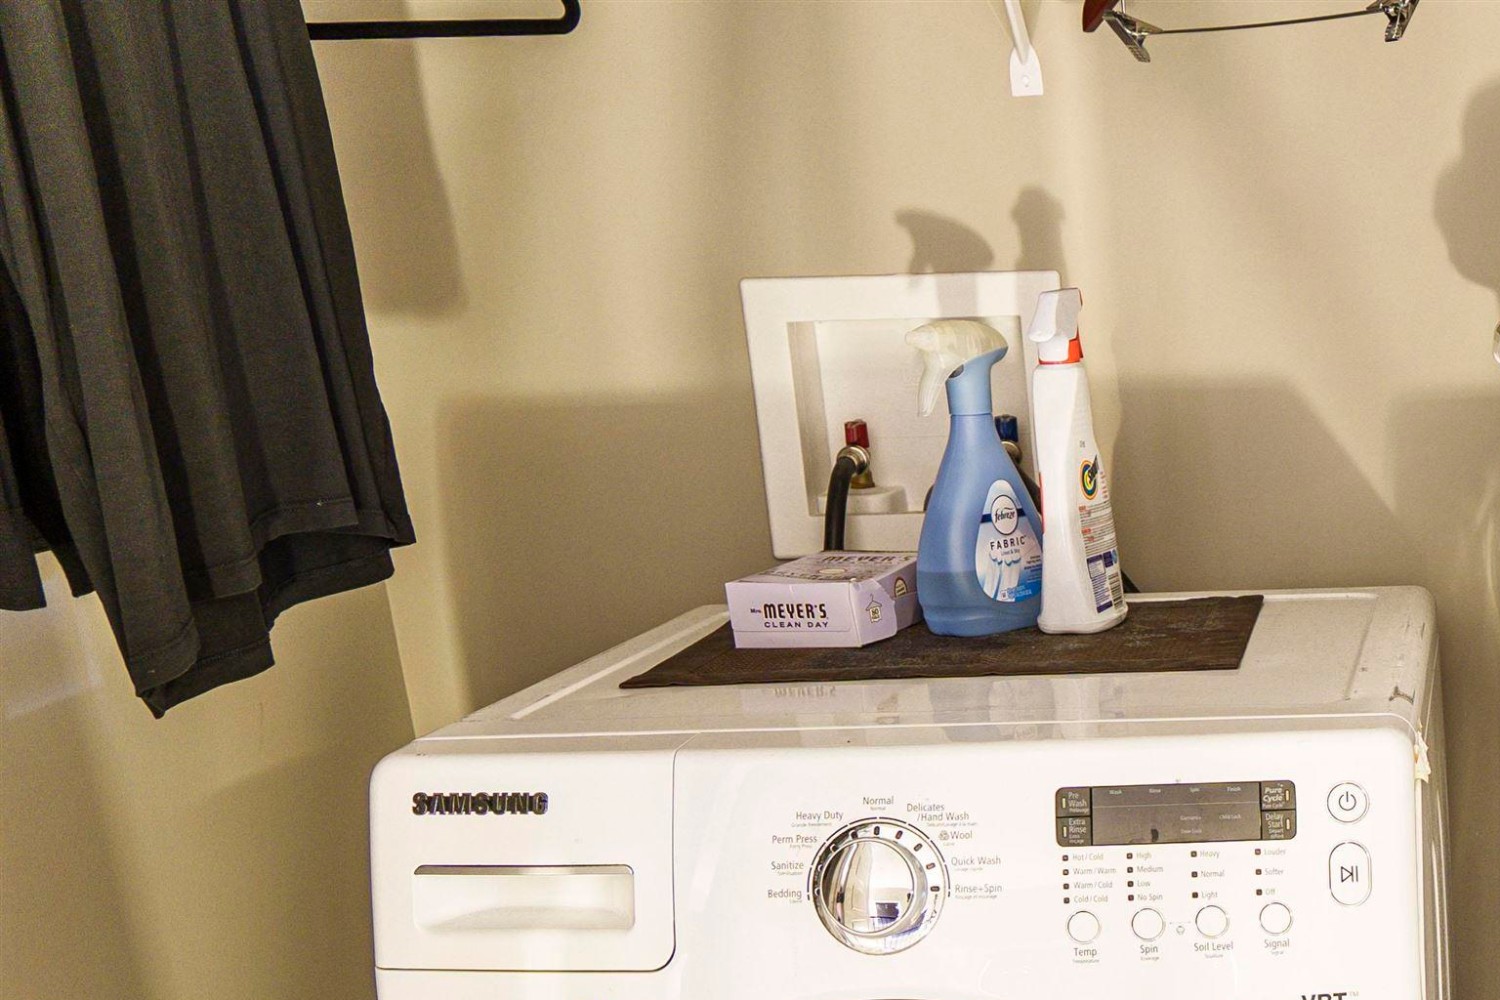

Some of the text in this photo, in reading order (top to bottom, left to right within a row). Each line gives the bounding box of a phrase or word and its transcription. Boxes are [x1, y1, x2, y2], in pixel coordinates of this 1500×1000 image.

[990, 537, 1025, 550] FABRIC
[764, 603, 827, 619] MEYER'S
[1068, 791, 1078, 799] Pre
[412, 792, 549, 815] SAMSUNG
[863, 796, 894, 805] Normal
[1068, 799, 1087, 807] Wash
[906, 803, 945, 812] Delicates
[796, 810, 844, 822] Heavy Duty
[917, 812, 970, 821] /Hand Wash
[1265, 813, 1283, 821] Delay
[1068, 825, 1087, 833] Rinse
[772, 835, 817, 844] Perm Press
[950, 831, 973, 839] Wool
[1137, 852, 1151, 860] High
[1200, 851, 1220, 859] Heavy
[771, 861, 804, 870] Sanitize
[951, 856, 1001, 866] Quick Wash
[768, 889, 802, 899] Bedding
[1148, 894, 1163, 902] Spin
[1201, 891, 1218, 900] Light
[1193, 941, 1234, 951] Soil Level
[1264, 939, 1290, 949] Signal
[1140, 944, 1158, 955] Spin
